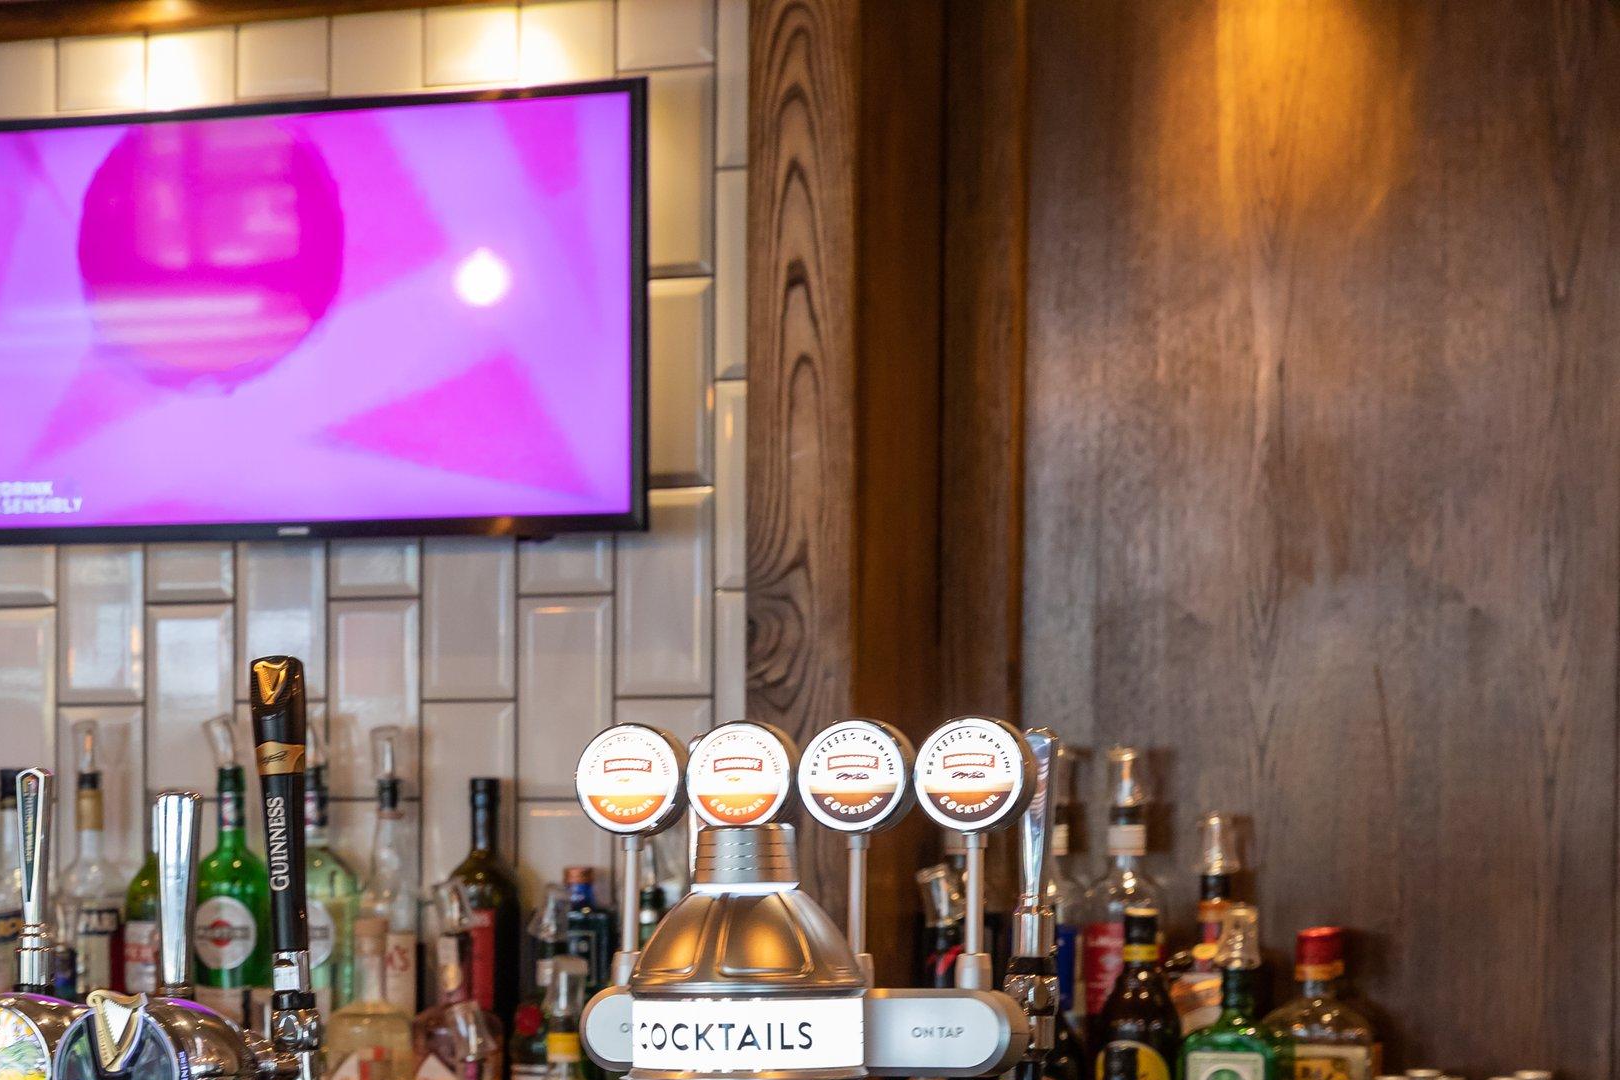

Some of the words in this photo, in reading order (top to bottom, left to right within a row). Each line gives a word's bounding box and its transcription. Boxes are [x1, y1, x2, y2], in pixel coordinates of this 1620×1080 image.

[823, 795, 884, 815] COCKTAIL
[939, 794, 1000, 814] COCKTAIL
[265, 796, 292, 892] GUINNESS
[639, 1021, 814, 1051] COCKTAILS
[910, 1026, 935, 1040] ON
[936, 1026, 965, 1040] TAP
